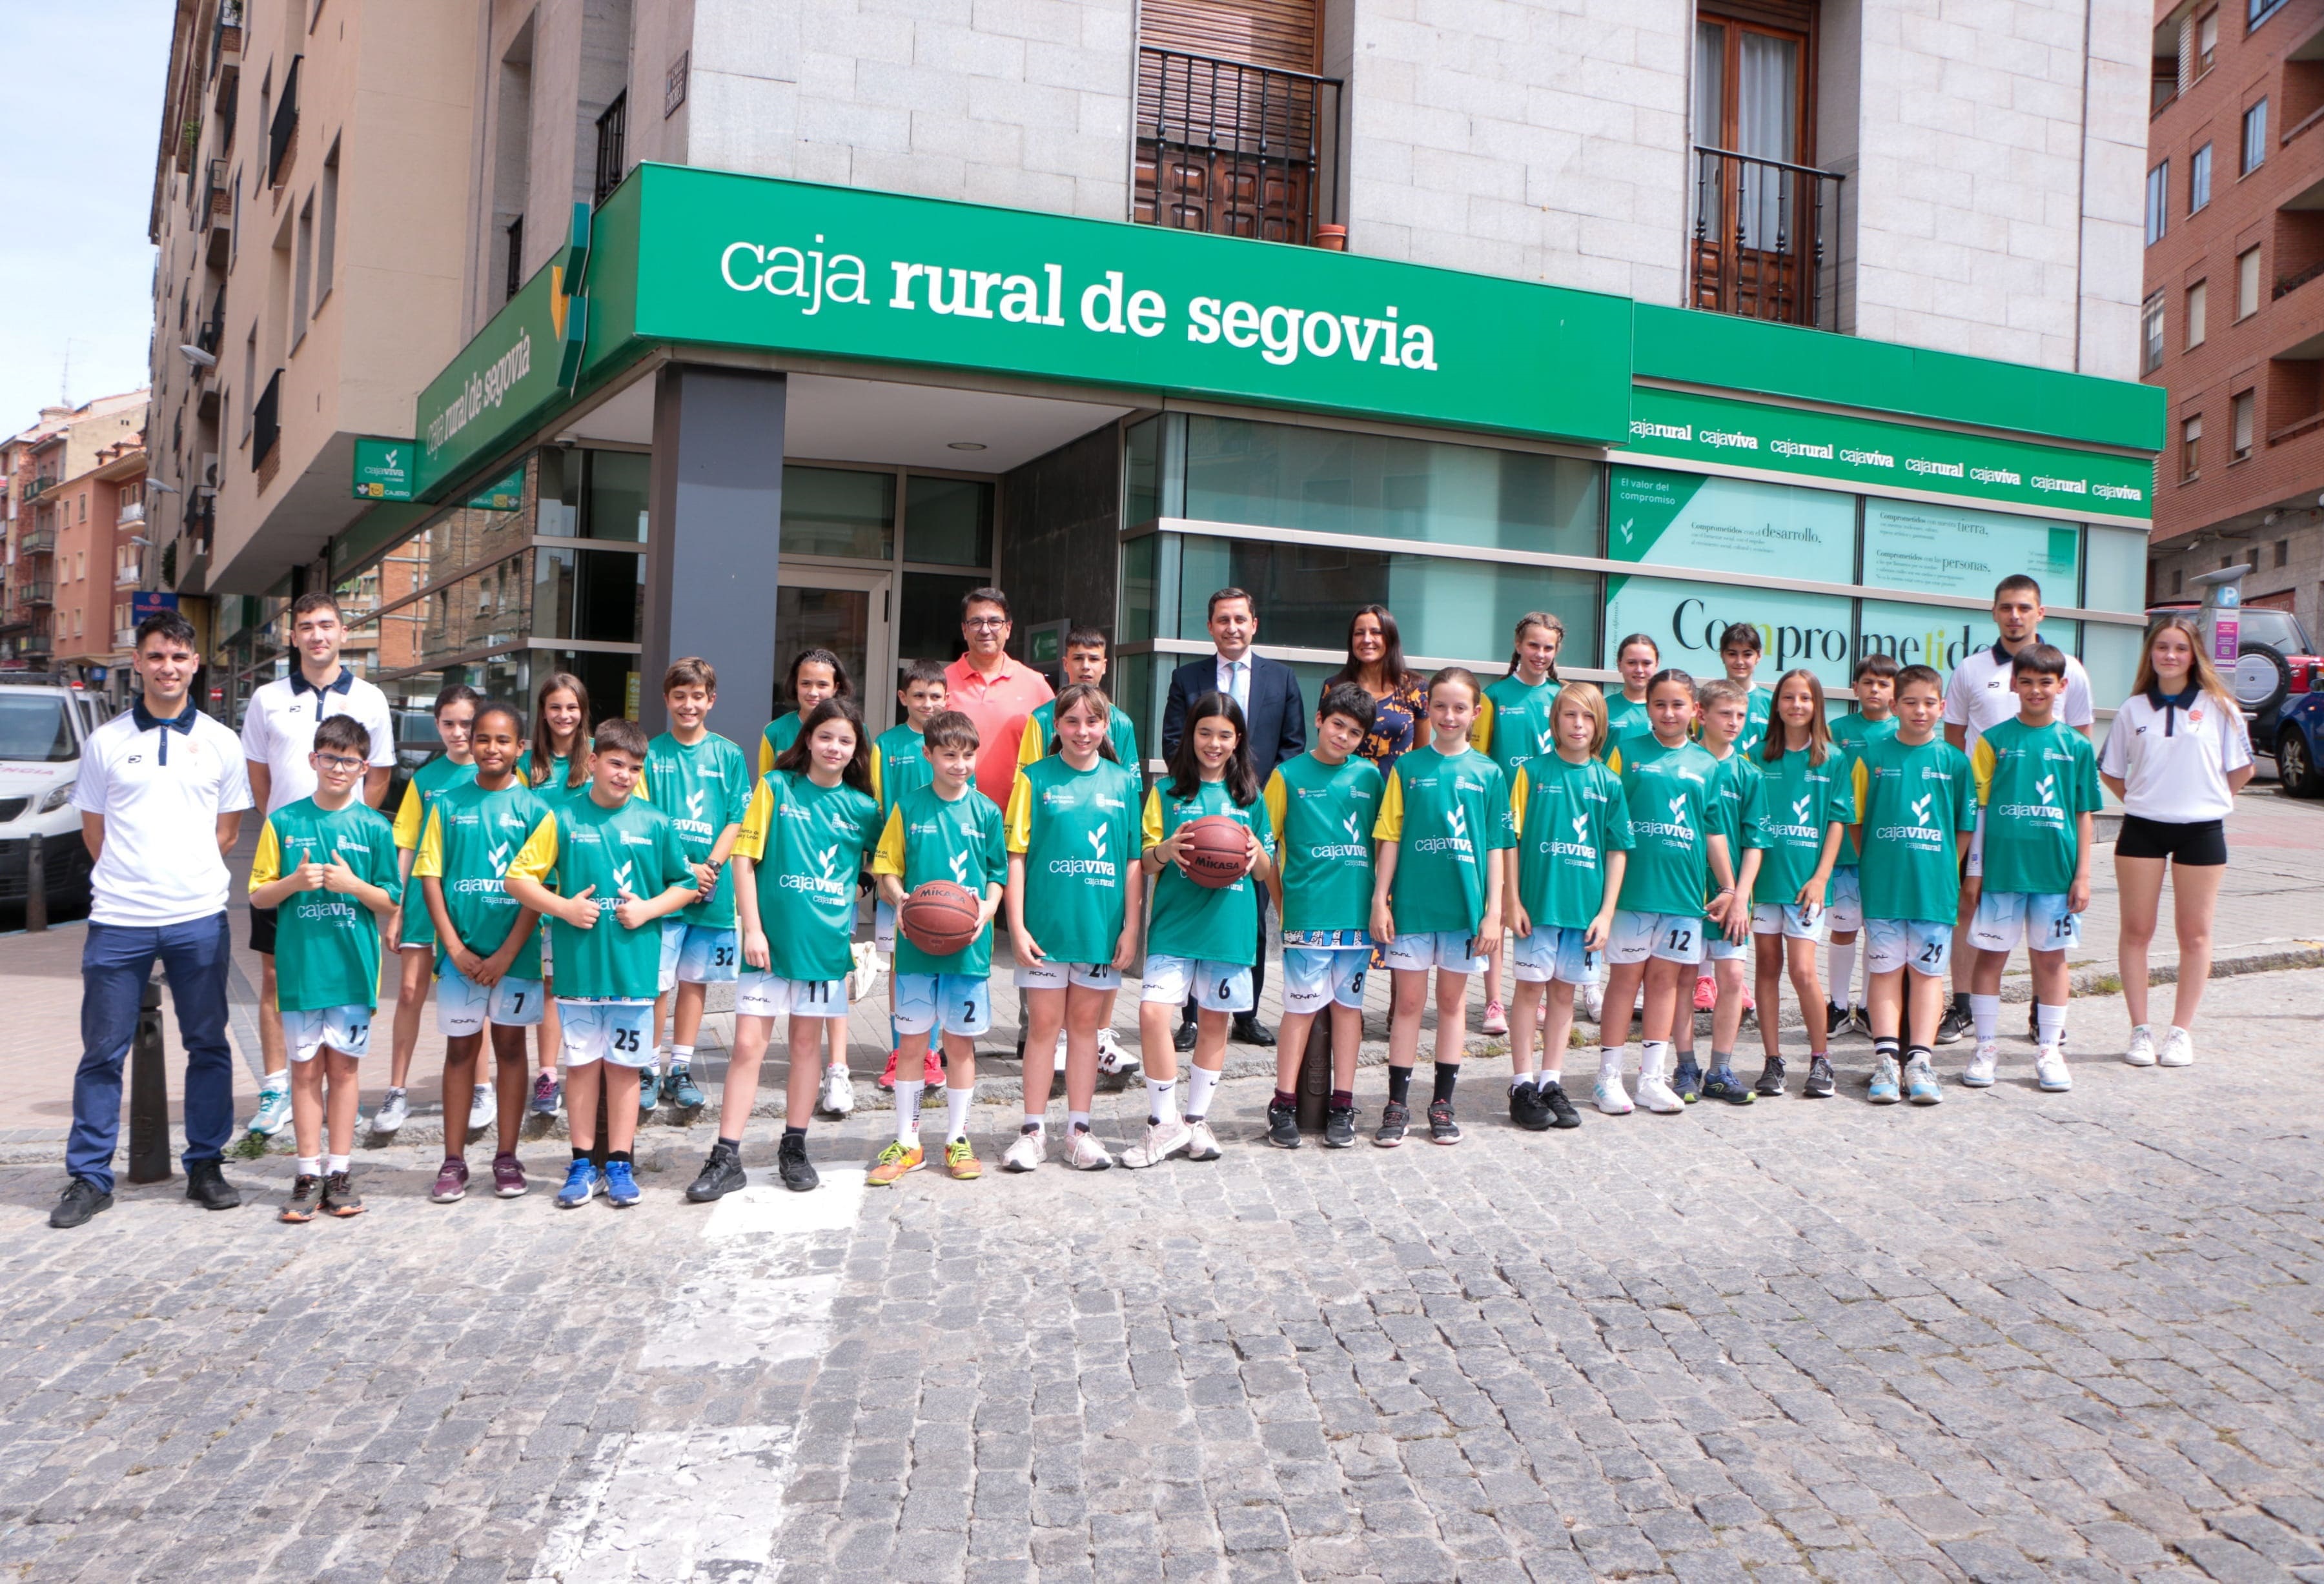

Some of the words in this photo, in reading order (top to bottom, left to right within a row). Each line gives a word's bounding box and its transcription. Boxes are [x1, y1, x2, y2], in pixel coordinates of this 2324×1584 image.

[721, 234, 870, 315] caja
[890, 261, 1065, 326] rural
[1081, 270, 1167, 338] de
[1187, 296, 1438, 371] segovia
[427, 405, 444, 461] caja
[444, 380, 468, 442] rural
[469, 371, 482, 420] de
[484, 326, 531, 408] segovia
[363, 465, 405, 476] cajaviva
[1699, 428, 1758, 450] cajaviva
[1770, 438, 1834, 460] cajarural
[1840, 447, 1895, 468] cajaviva
[1905, 457, 1964, 478] cajarural
[1970, 466, 2021, 486] cajaviva
[2031, 474, 2086, 494] cajarural
[2092, 483, 2142, 502] cajaviva
[1621, 478, 1629, 487] El
[1631, 480, 1653, 489] valor
[1656, 483, 1669, 491] del
[1620, 491, 1676, 505] compromiso
[1691, 521, 1742, 534] Comprometidos
[1762, 523, 1822, 544] desarrollo.
[1880, 511, 1926, 524] Comprometidos
[1957, 518, 1989, 535] tierra.
[1876, 549, 1922, 562] Comprometidos
[1942, 557, 1991, 573] personas.
[1999, 802, 2064, 820] cajaviva
[672, 817, 713, 835] aviva
[1632, 818, 1695, 841] cajaviva
[1768, 821, 1819, 839] ajaviva
[1876, 822, 1942, 842] cajaviva
[1311, 841, 1367, 860] cajaviva
[1540, 838, 1596, 859] cajaviva
[1049, 856, 1116, 877] cajaviva
[453, 875, 506, 895] cajaviv
[779, 871, 844, 897] cajaviva
[2054, 915, 2072, 938] 15
[1668, 929, 1691, 952] 12
[715, 947, 734, 966] 32
[1920, 943, 1943, 964] 29
[808, 980, 830, 1004] 11
[1218, 977, 1231, 1000] 6
[1351, 971, 1364, 994] 8
[513, 992, 525, 1015] 7
[963, 1000, 976, 1023] 2
[615, 1028, 641, 1053] 25
